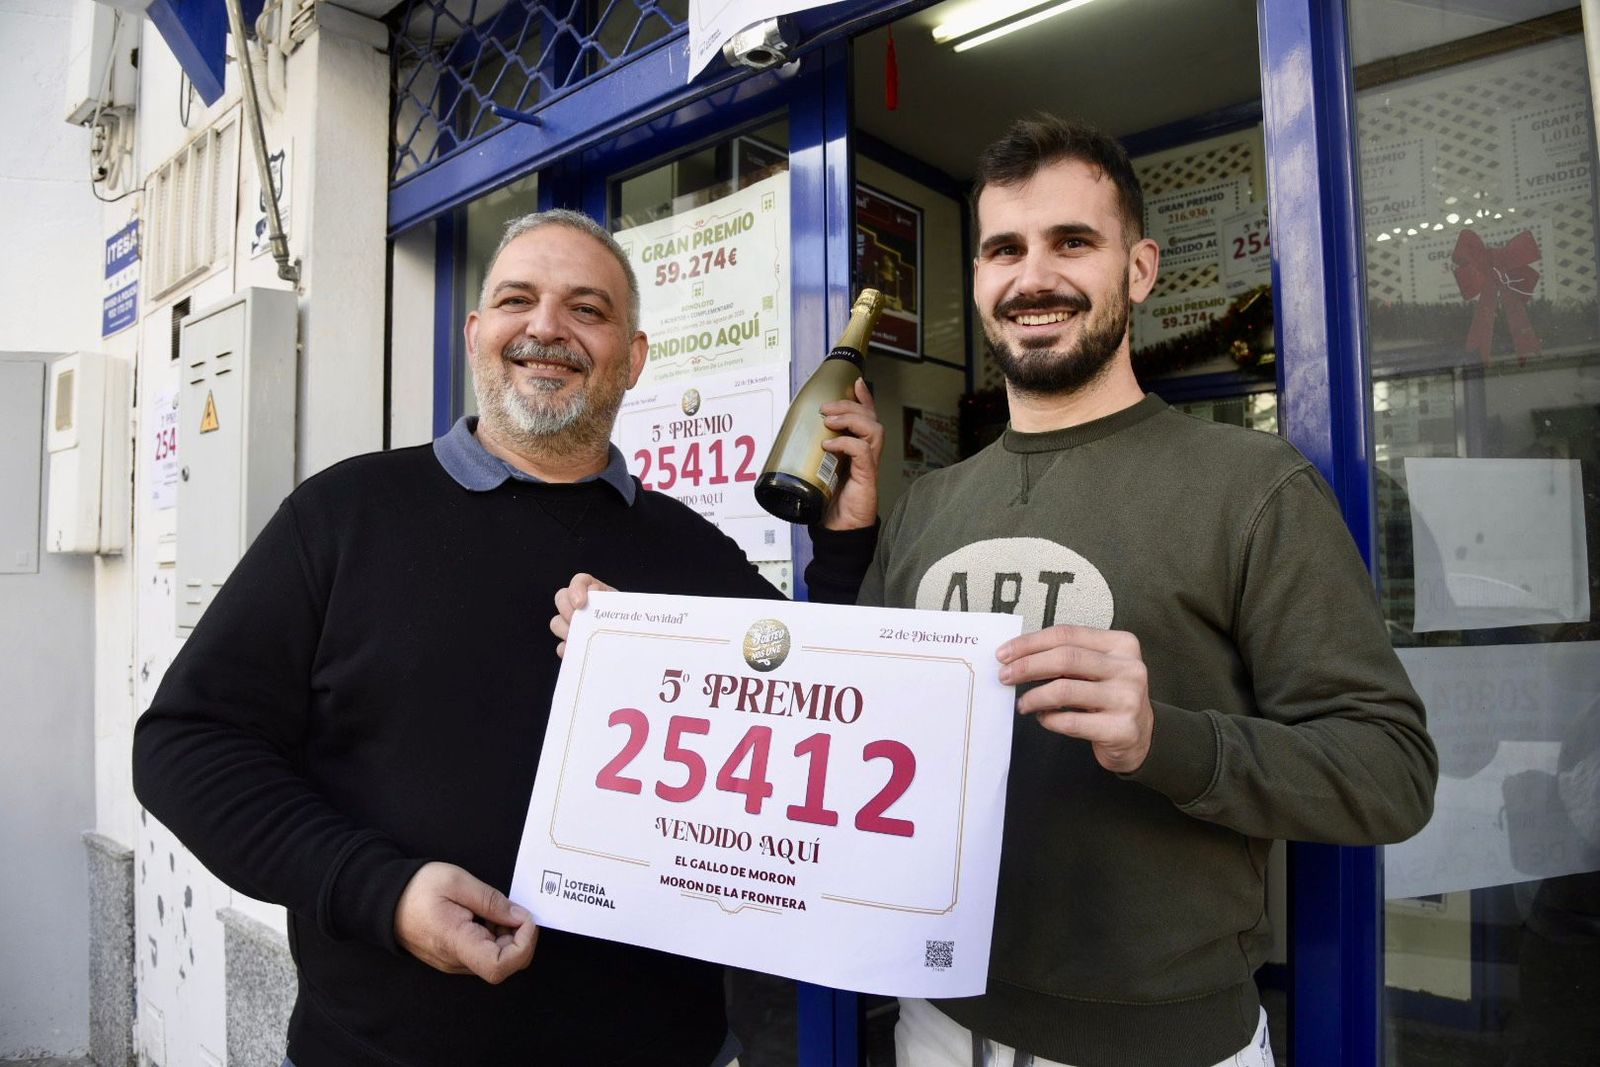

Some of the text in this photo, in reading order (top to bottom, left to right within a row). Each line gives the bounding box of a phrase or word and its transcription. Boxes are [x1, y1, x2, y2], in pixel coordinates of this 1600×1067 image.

[1525, 166, 1589, 187] VENDID
[642, 211, 754, 263] GRAN PREMIO
[1160, 241, 1203, 257] ENDIDO
[649, 331, 712, 362] ENDIDO
[715, 311, 760, 347] AQUÍ
[668, 413, 733, 440] PREMIO
[156, 427, 176, 460] 254
[634, 435, 757, 491] 25412
[630, 611, 643, 621] de
[879, 628, 979, 645] 22 de Diciembre
[702, 673, 864, 724] PREMIO
[594, 707, 917, 838] 25412
[655, 817, 820, 865] VENDIDO AQUÍ
[675, 855, 796, 886] EL GALLO DE MORON
[563, 889, 616, 910] NACIONAL
[564, 879, 606, 896] LOTERÍA
[660, 875, 807, 911] MORON DE LA FRONTERA
